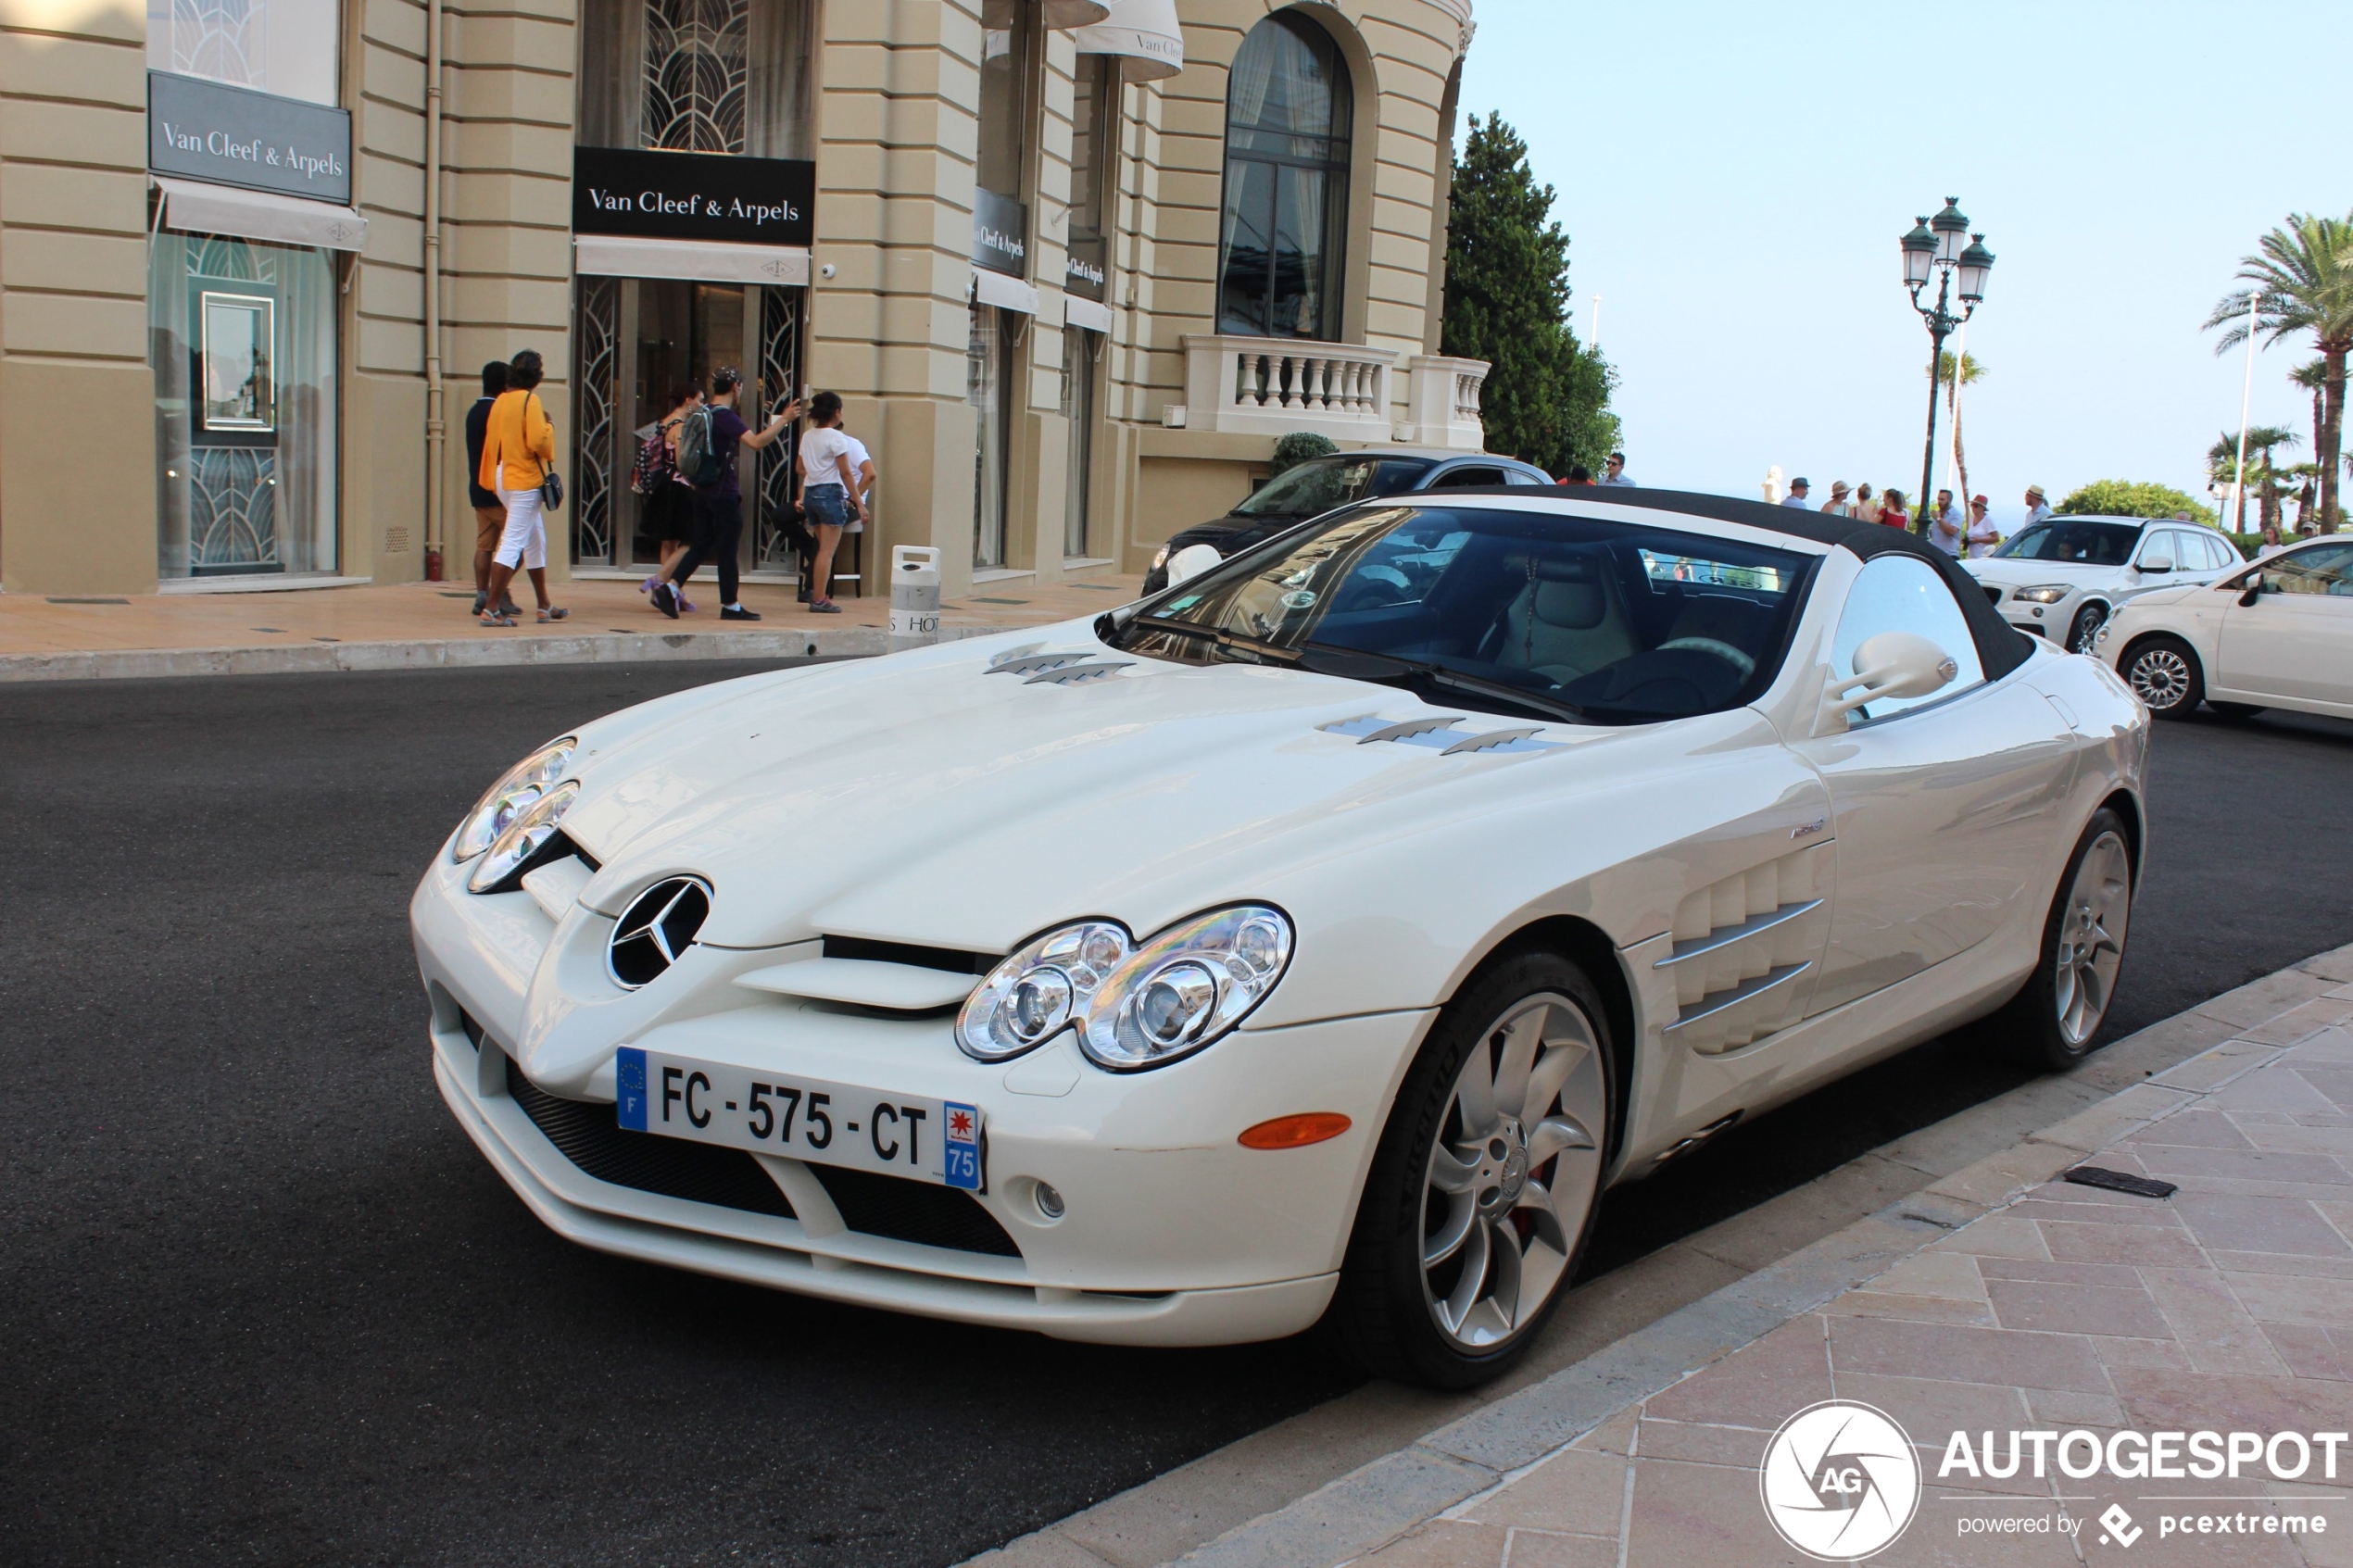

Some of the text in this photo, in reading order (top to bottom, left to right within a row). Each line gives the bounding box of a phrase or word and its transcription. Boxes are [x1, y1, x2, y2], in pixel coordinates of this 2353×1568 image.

[1137, 34, 1160, 53] Van
[162, 122, 342, 179] Van Cleef & Arpels
[589, 188, 799, 225] Van Cleef & Arpels
[981, 226, 999, 248] Cleef
[1004, 234, 1024, 260] Arpels
[627, 1098, 636, 1113] F
[1403, 1046, 1457, 1195] MICHELIN
[949, 1148, 975, 1178] 75
